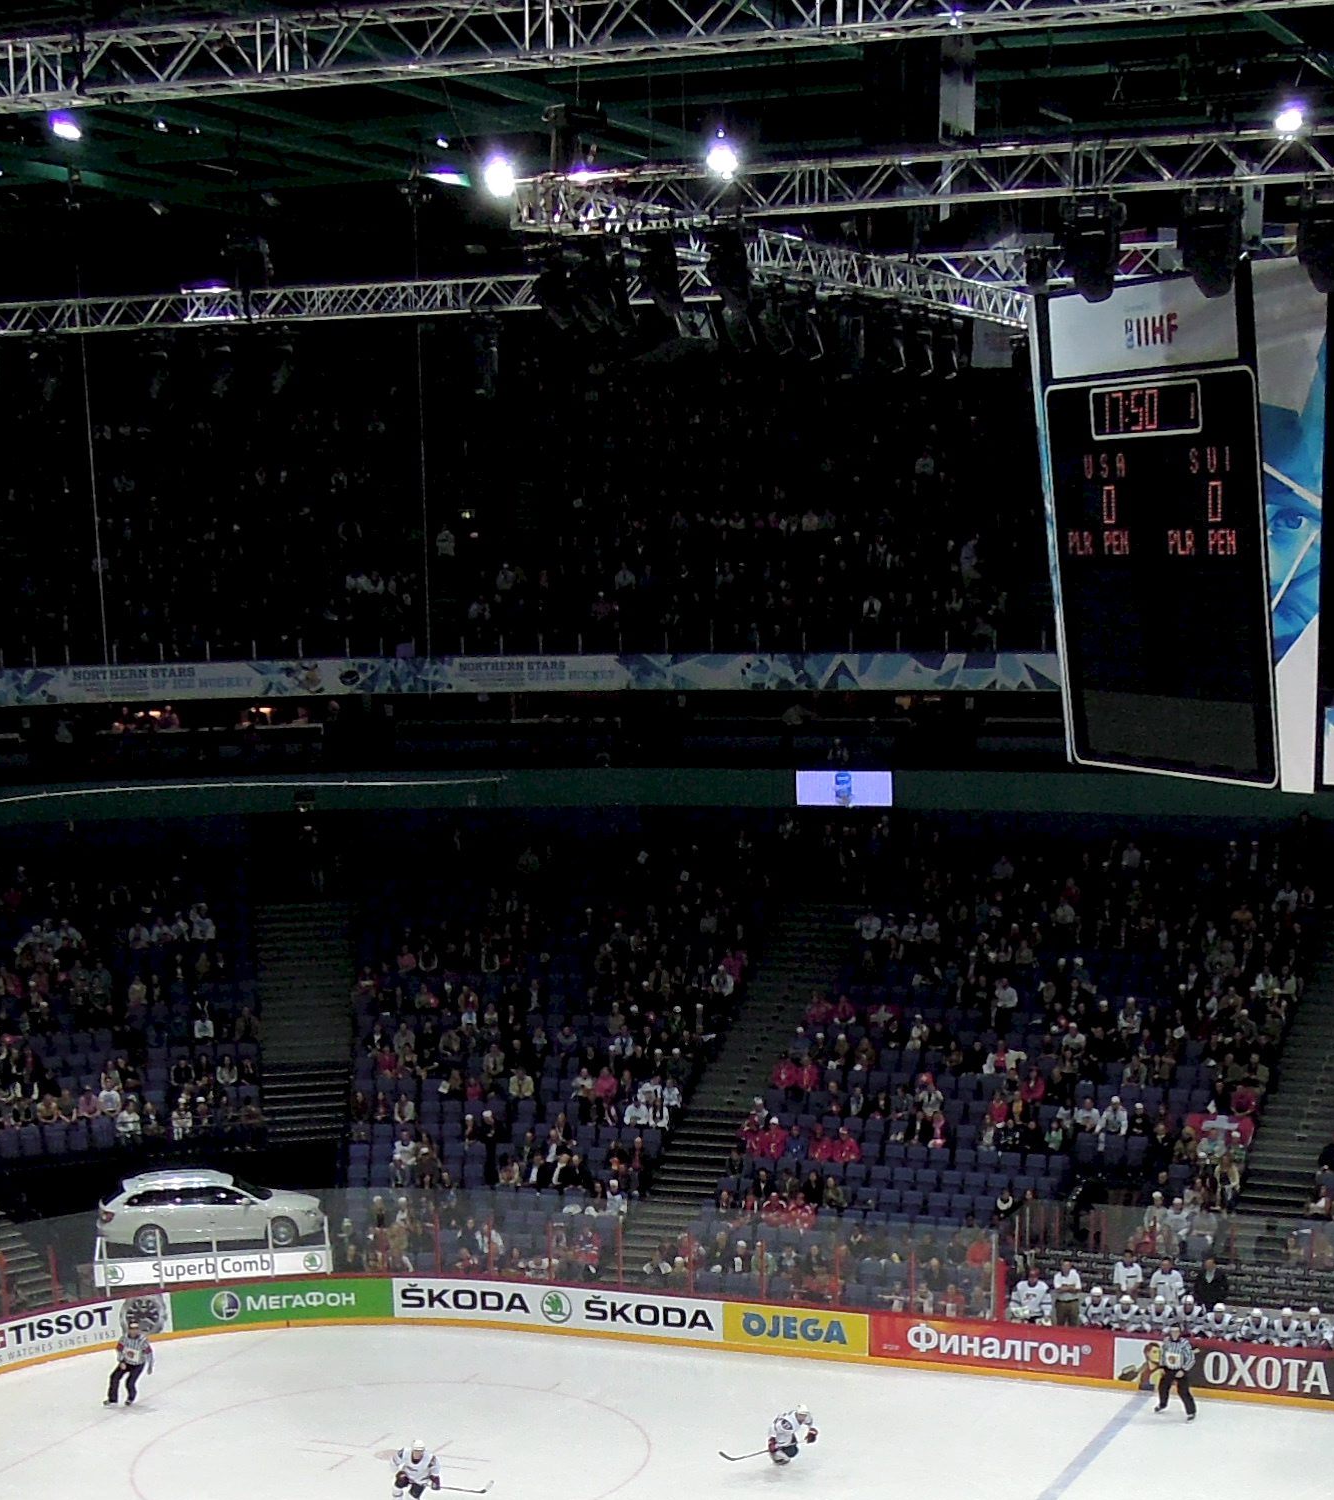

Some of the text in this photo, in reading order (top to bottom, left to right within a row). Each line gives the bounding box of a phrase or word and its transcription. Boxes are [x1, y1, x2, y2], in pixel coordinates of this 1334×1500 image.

[1136, 313, 1178, 347] IIHF
[1105, 389, 1159, 433] 17:50
[1083, 453, 1126, 479] USA
[1189, 446, 1230, 474] SUI
[1103, 485, 1115, 524] 0
[1208, 481, 1222, 522] 0
[1068, 531, 1093, 555] PLR
[1168, 530, 1195, 555] PLR
[73, 667, 196, 680] NORTHERN STARS
[401, 1283, 715, 1332] ŠKODA ŠKODA
[7, 1306, 113, 1345] TISSOT
[7, 1342, 53, 1361] WATCHES
[58, 1335, 88, 1351] SINCE
[92, 1329, 117, 1344] 1853
[1203, 1351, 1331, 1396] ОХОТА
